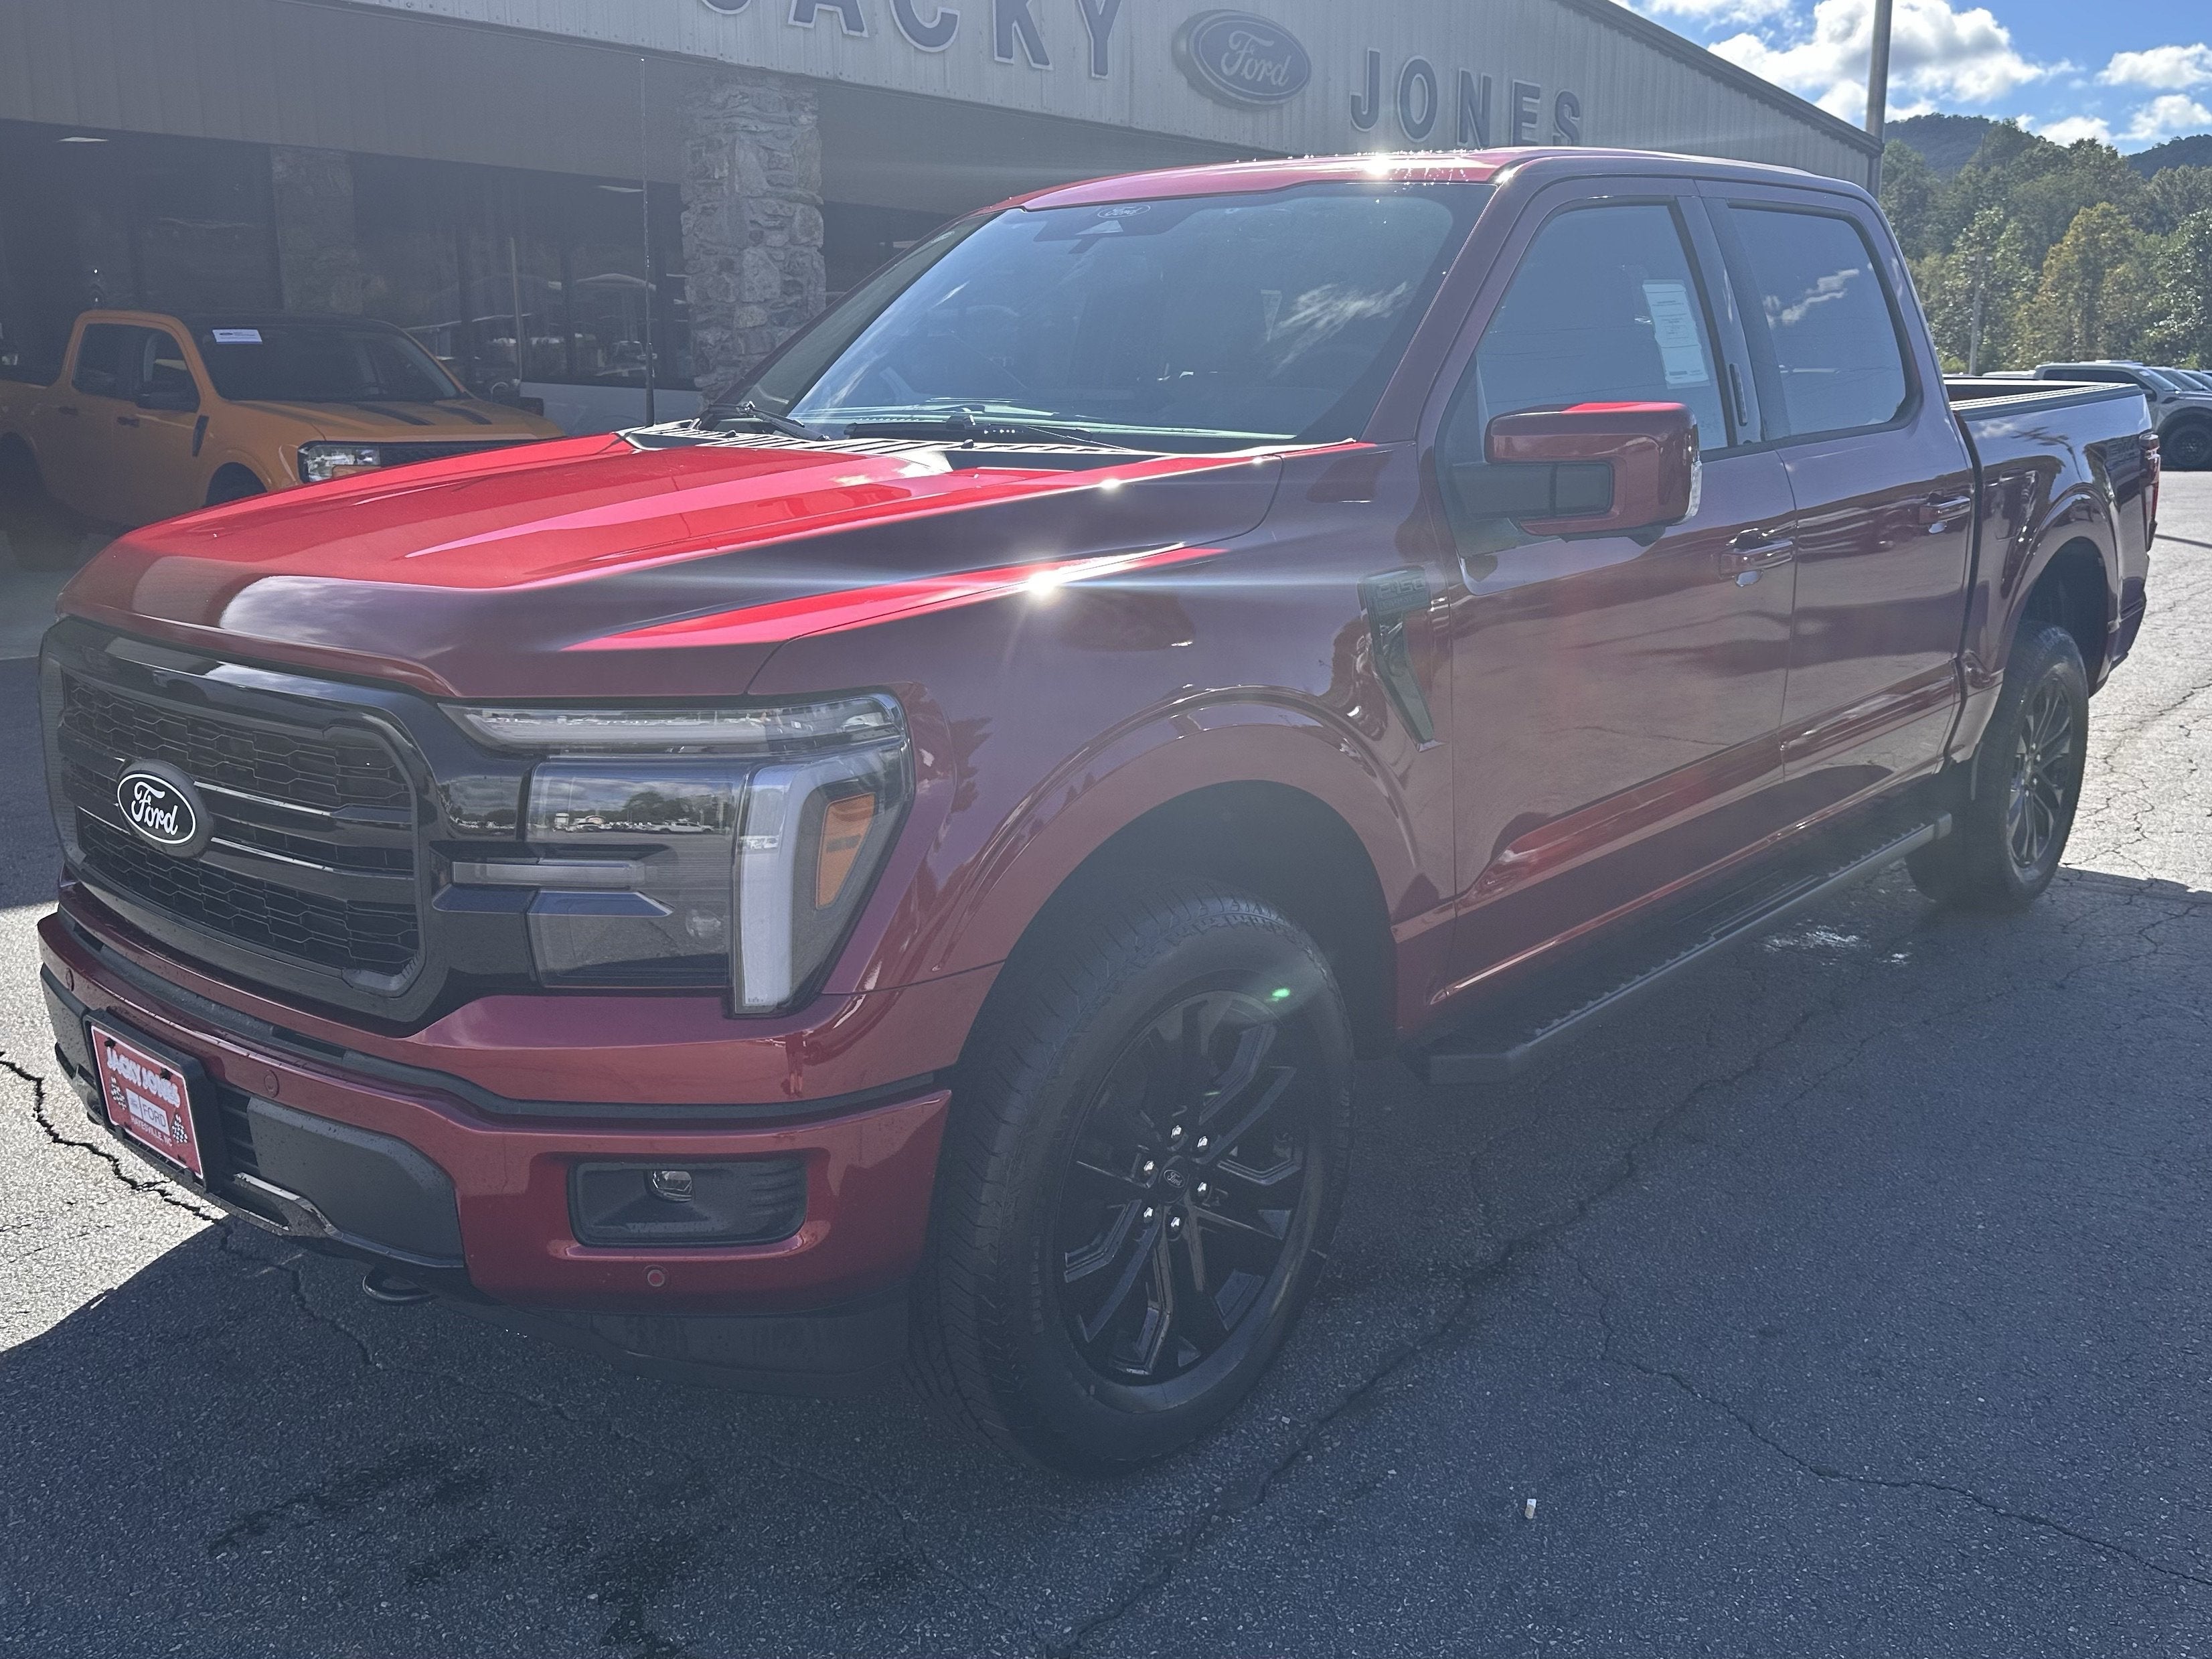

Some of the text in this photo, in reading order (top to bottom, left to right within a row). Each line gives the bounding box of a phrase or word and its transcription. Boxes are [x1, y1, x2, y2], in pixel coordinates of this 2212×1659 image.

[1220, 30, 1290, 88] Ford
[1350, 48, 1581, 147] JONES
[131, 781, 178, 836] Ford
[106, 1046, 181, 1108] JACKY JONES
[143, 1103, 166, 1127] FORD
